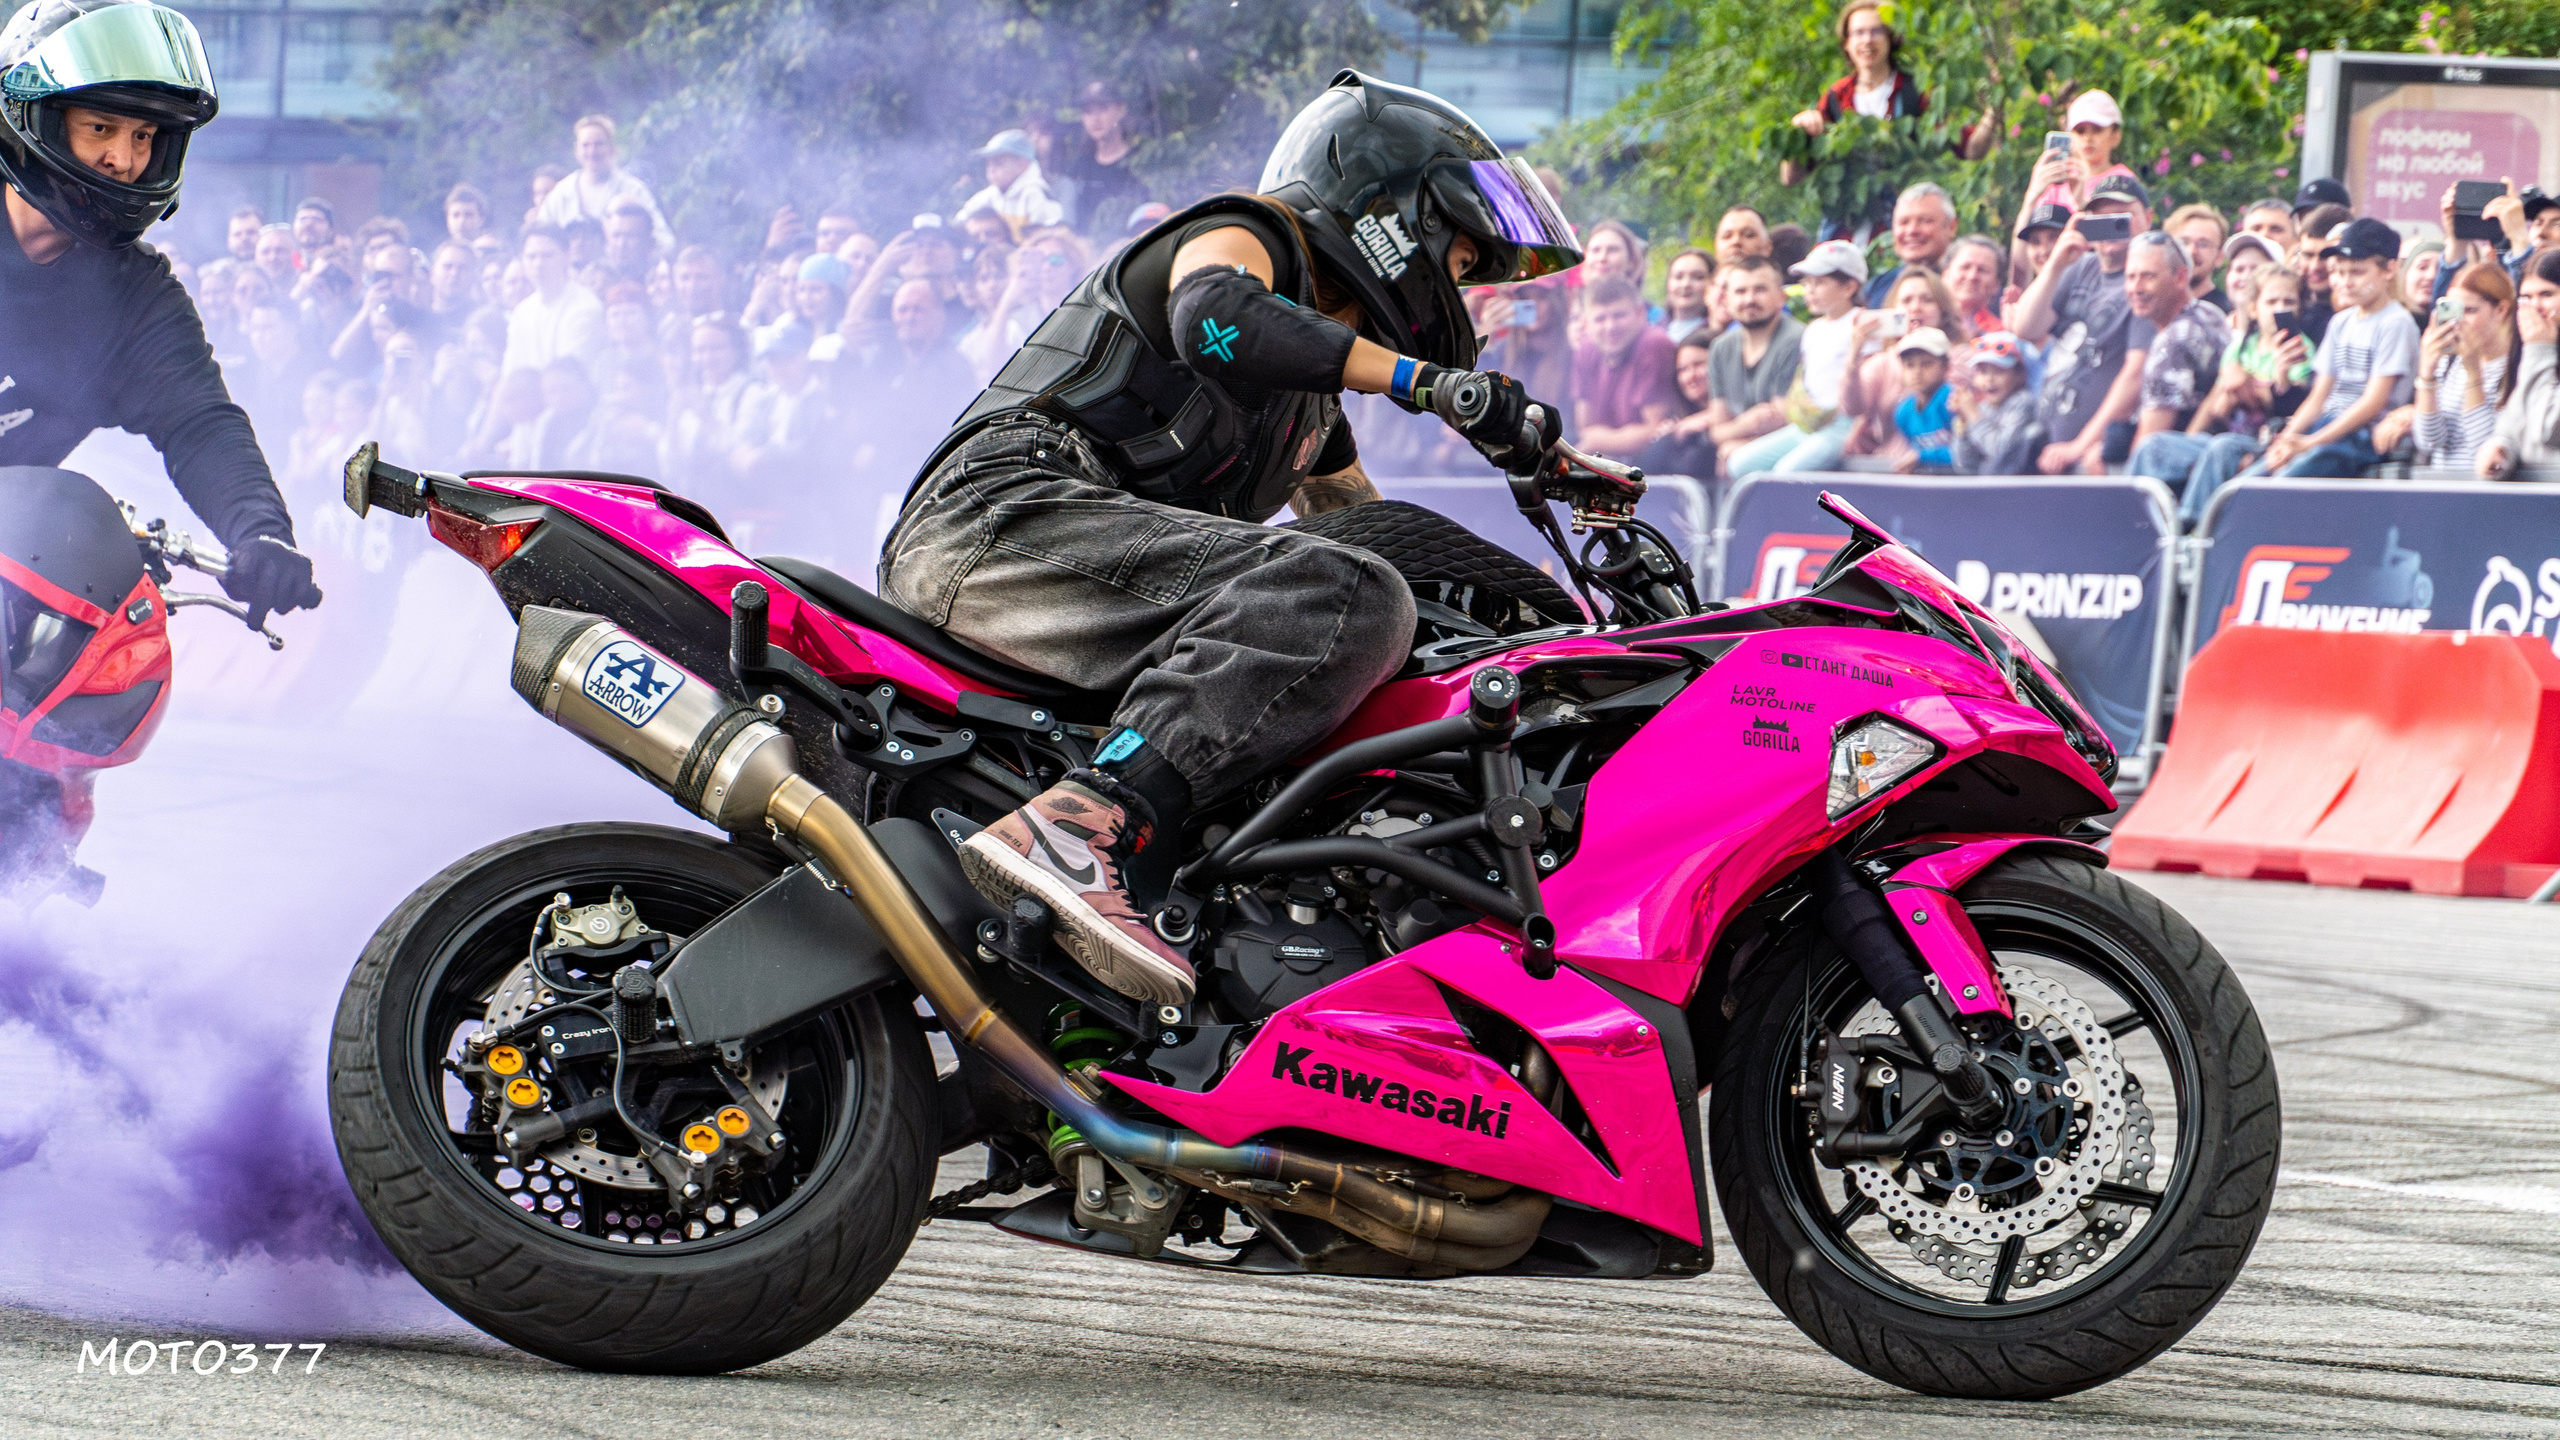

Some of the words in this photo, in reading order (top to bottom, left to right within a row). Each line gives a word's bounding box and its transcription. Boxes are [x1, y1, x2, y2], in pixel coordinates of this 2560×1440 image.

[2378, 126, 2472, 152] лоферы
[2376, 155, 2406, 173] на
[2408, 150, 2484, 174] любой
[2375, 180, 2427, 202] вкус
[1351, 233, 1372, 259] ENERGY
[1367, 256, 1385, 278] DRINK
[1354, 213, 1408, 280] GORILLA
[1990, 572, 2143, 620] PRINZIP
[1805, 656, 1847, 677] СТАНТ
[1850, 665, 1894, 688] ДАША
[587, 674, 652, 721] ARROW
[1730, 695, 1816, 713] MOTOLINE
[1733, 684, 1776, 697] LAVR
[1743, 730, 1801, 753] GORILLA
[561, 1029, 592, 1040] Crazy
[1271, 1041, 1512, 1140] Kawasaki
[1832, 1062, 1846, 1112] NISSIN
